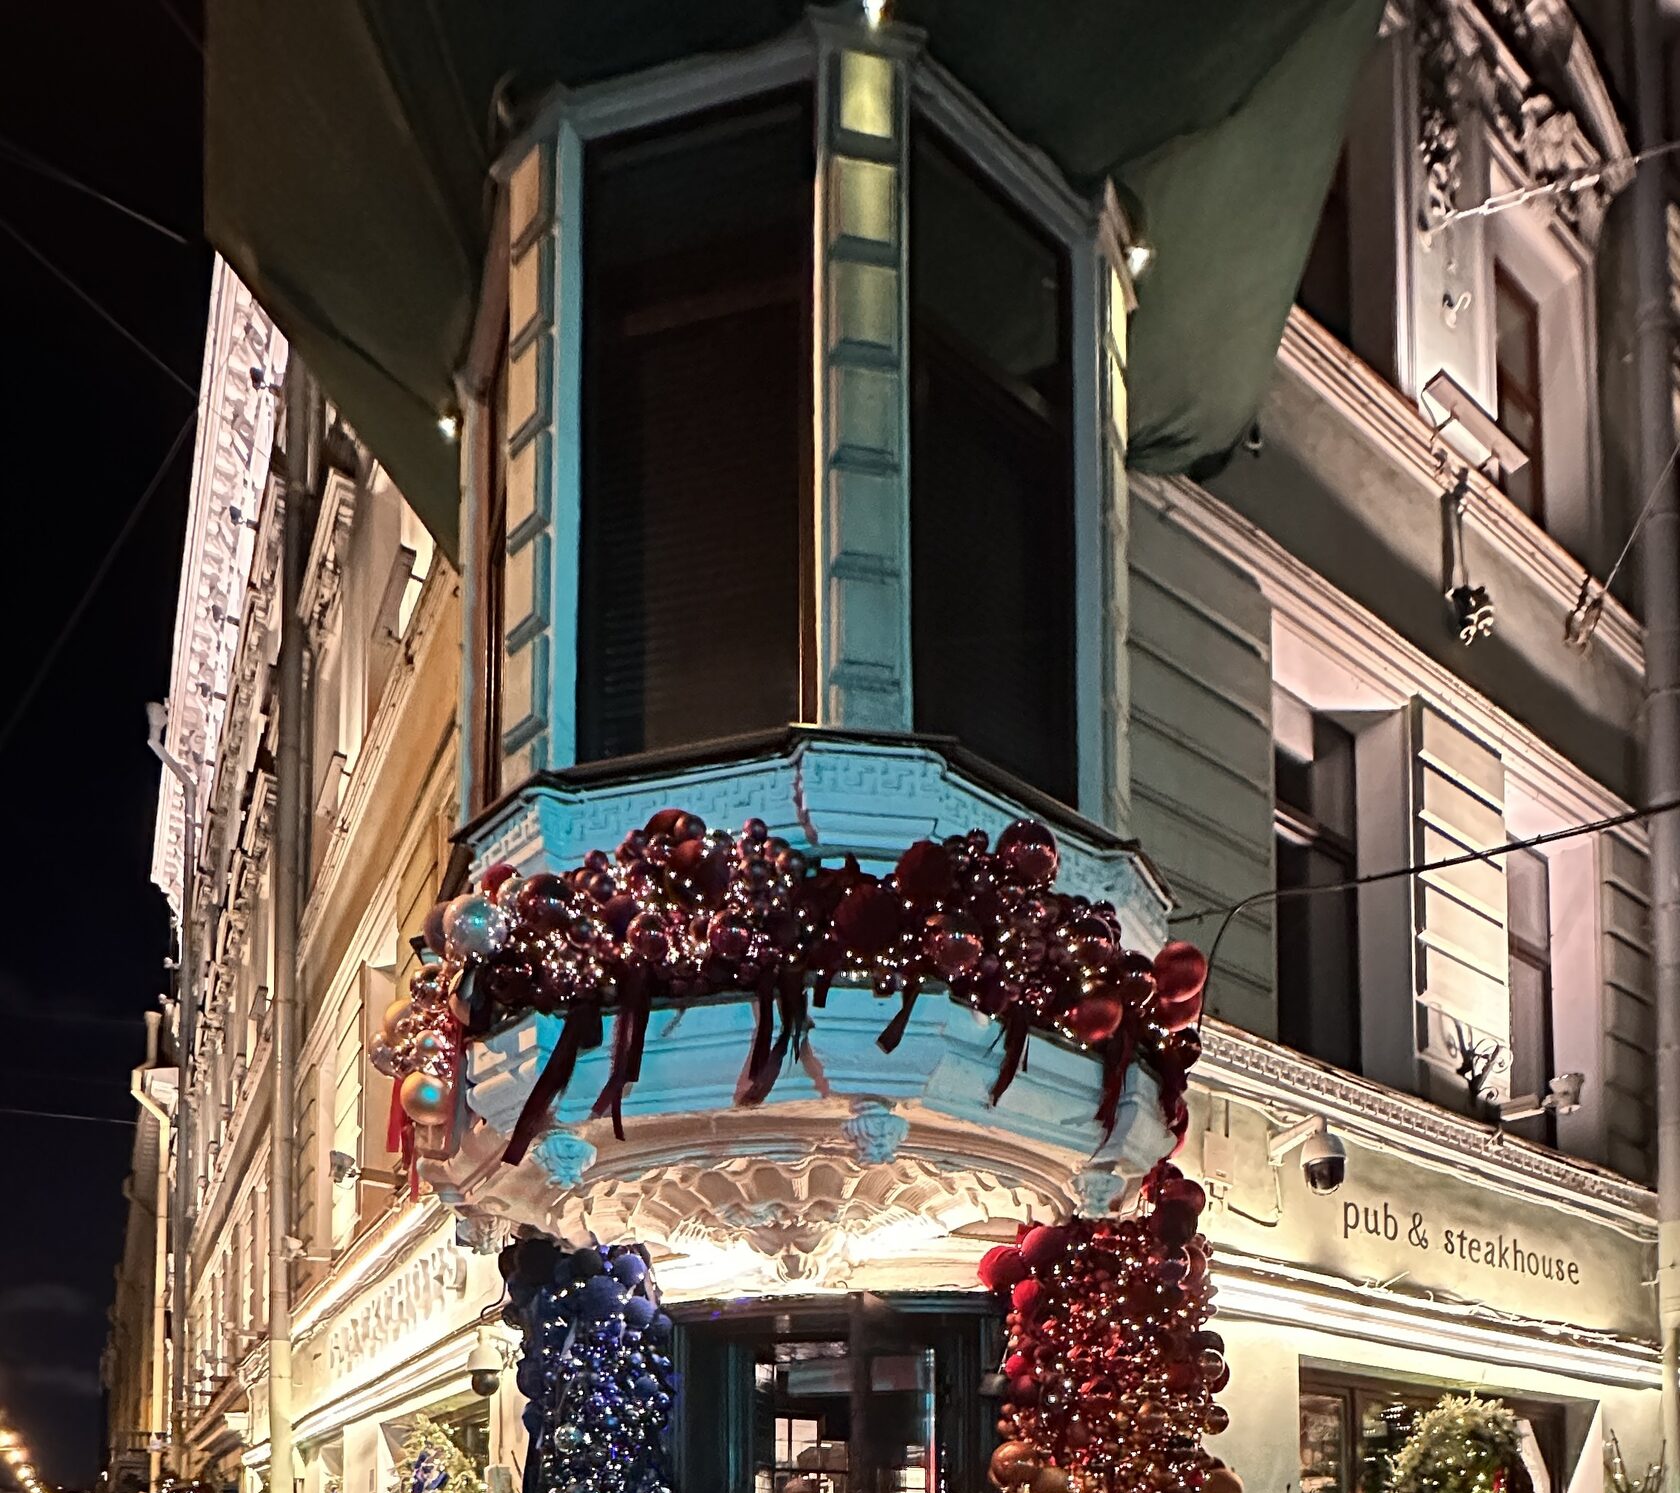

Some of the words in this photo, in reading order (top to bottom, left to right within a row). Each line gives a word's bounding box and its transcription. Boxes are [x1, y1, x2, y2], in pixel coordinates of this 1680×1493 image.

[1343, 1201, 1398, 1241] pub
[1408, 1212, 1429, 1250] &
[1443, 1229, 1580, 1284] steakhouse
